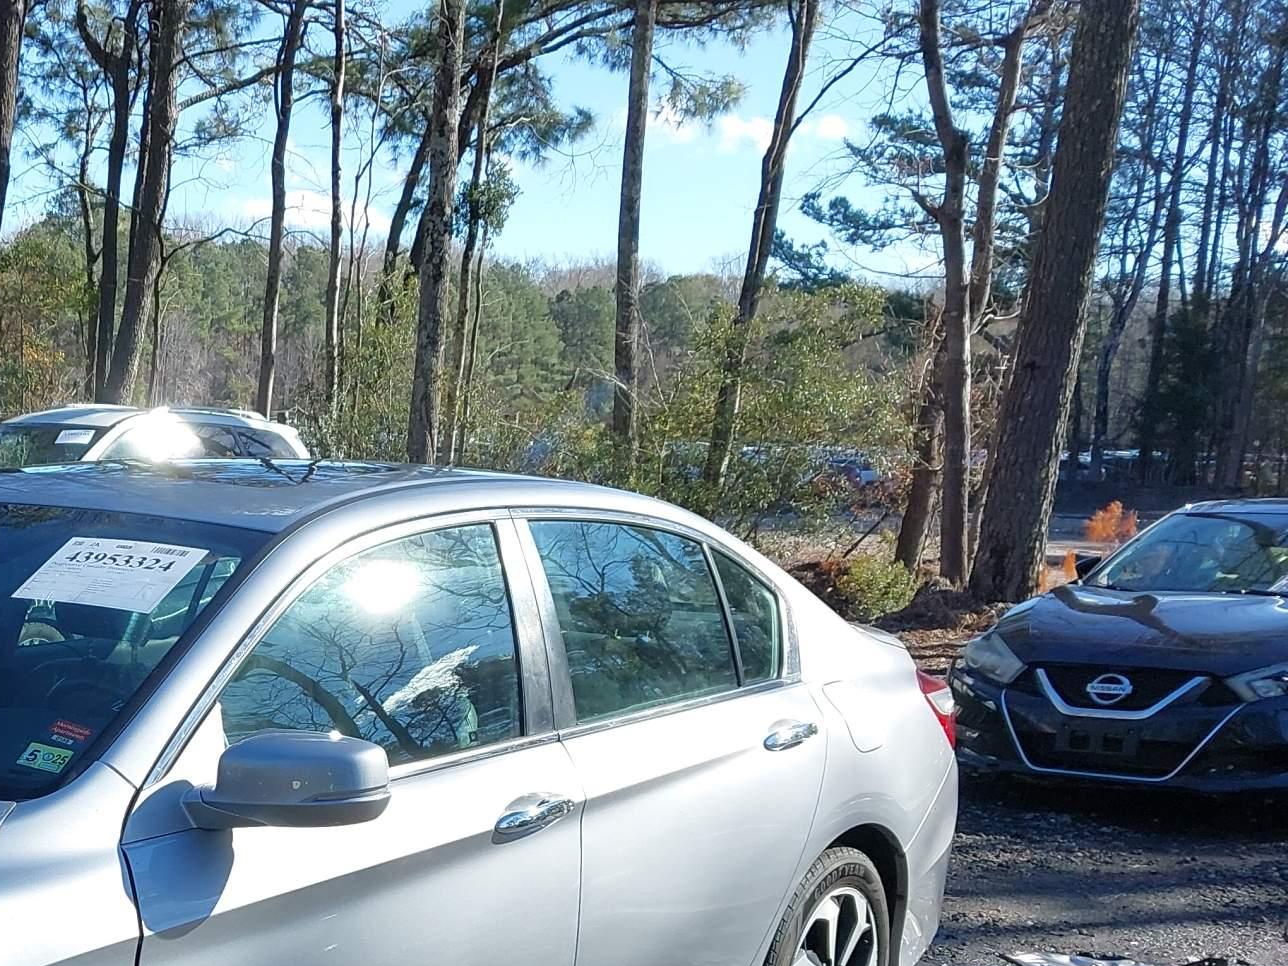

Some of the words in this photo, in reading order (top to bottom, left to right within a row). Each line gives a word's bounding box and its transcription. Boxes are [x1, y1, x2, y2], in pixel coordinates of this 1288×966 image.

[65, 550, 176, 572] 43953324
[25, 749, 41, 762] 5
[52, 754, 69, 766] 25
[814, 863, 865, 900] GOODYEAR
